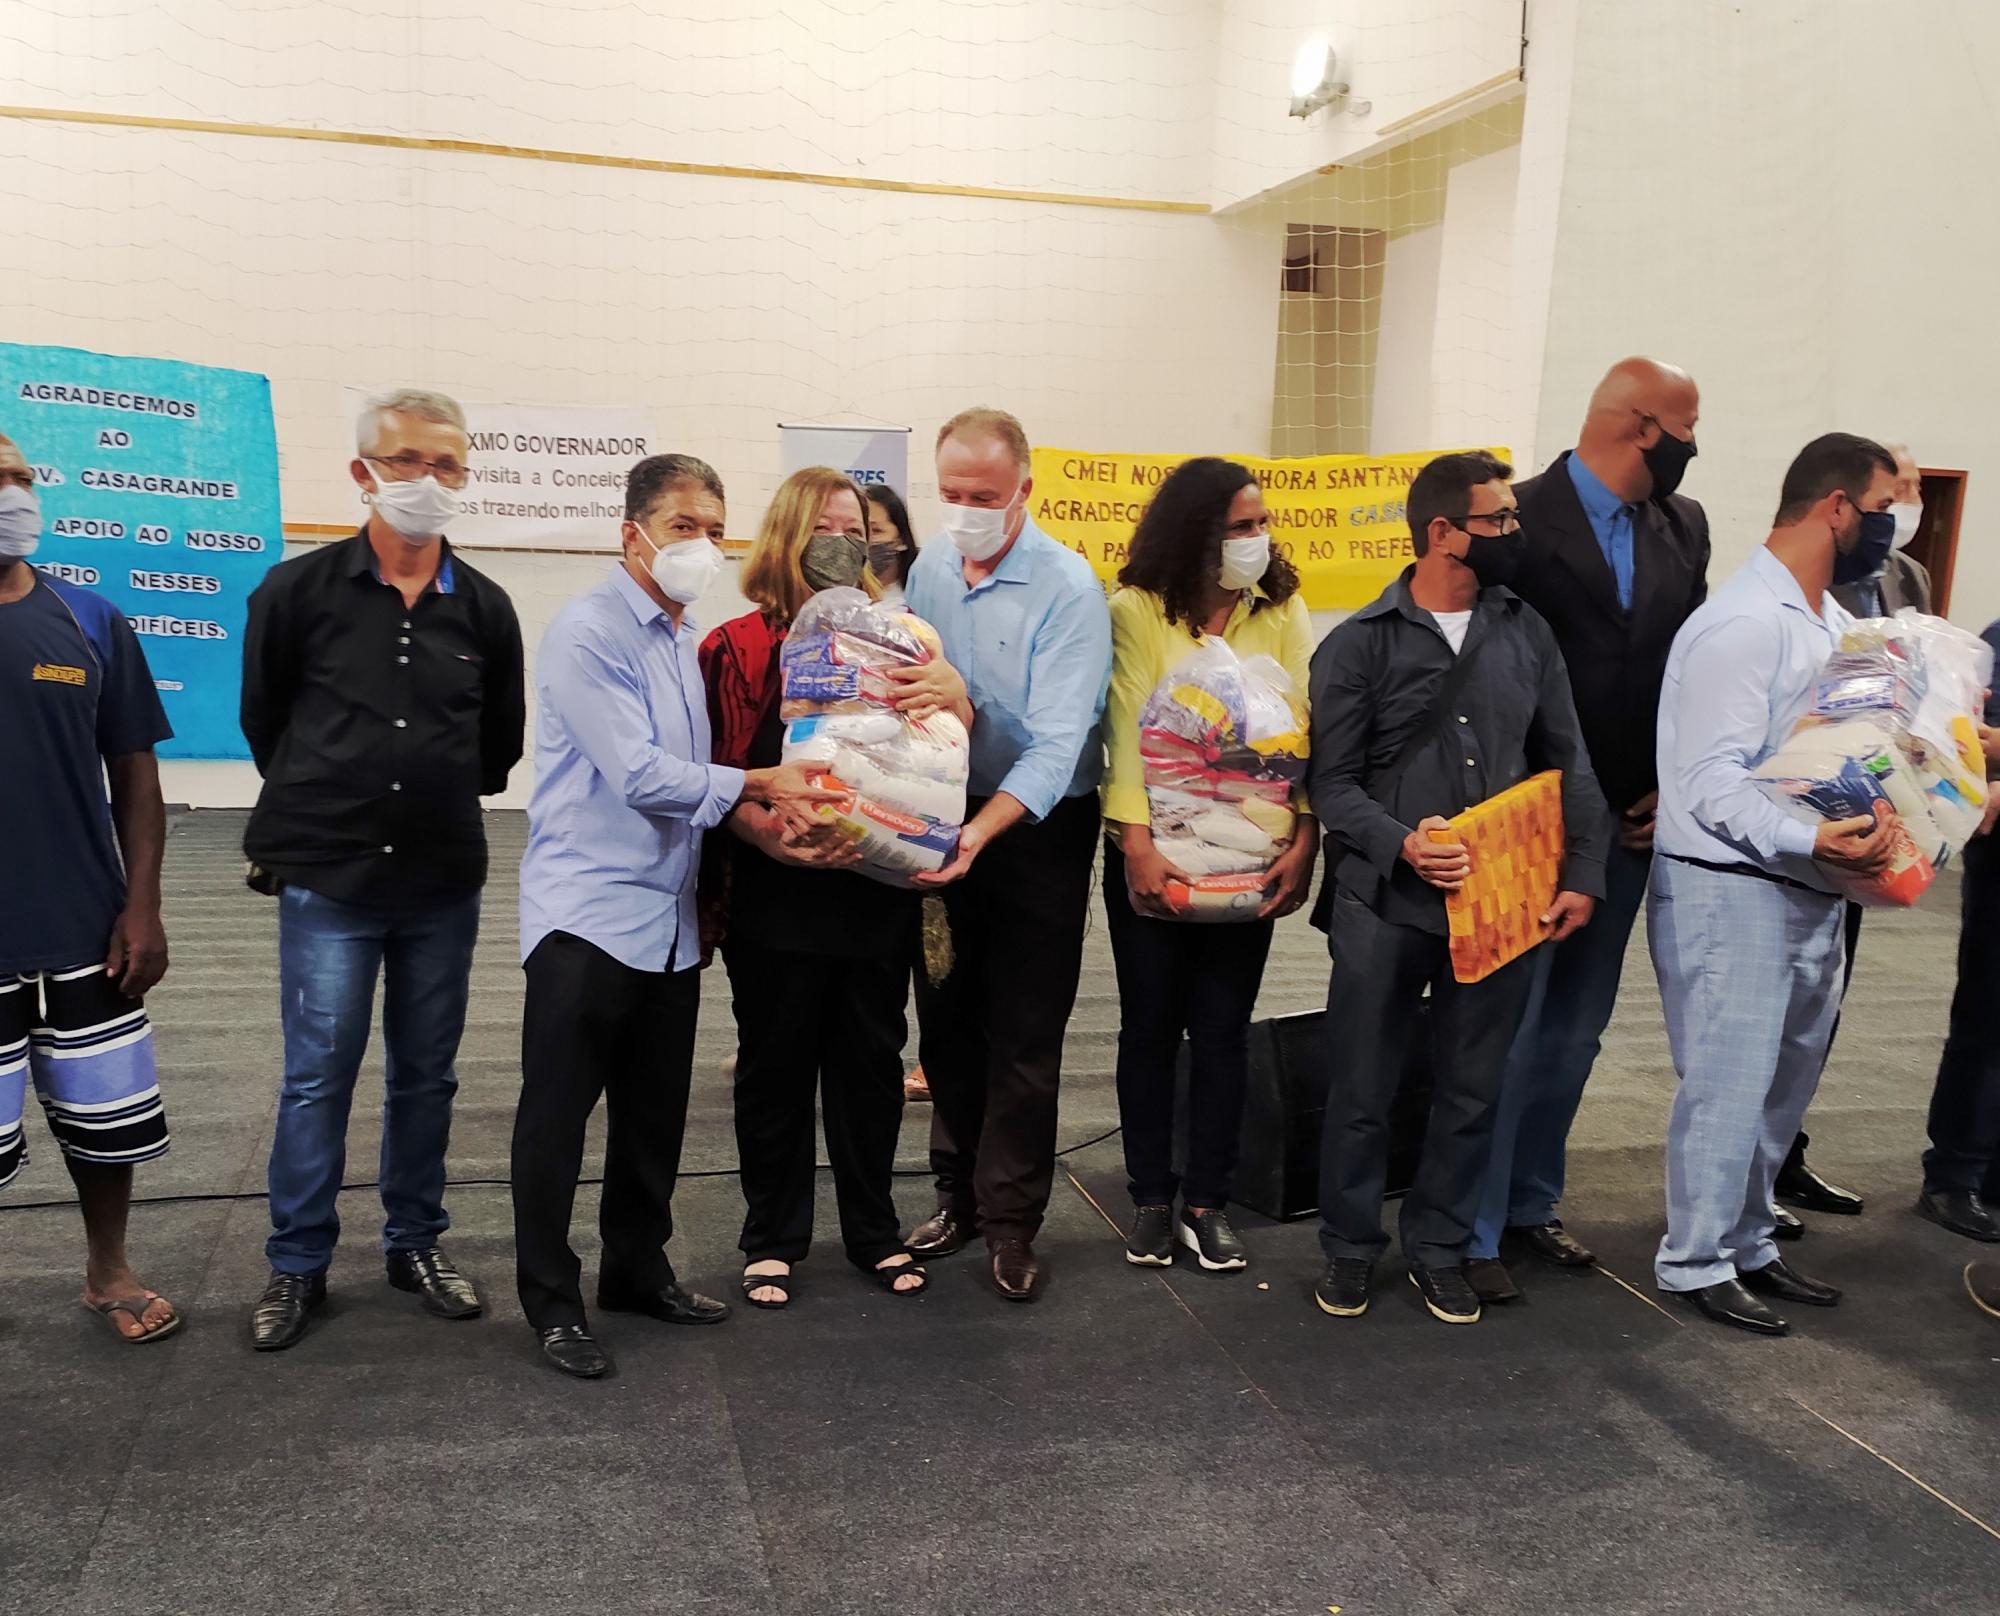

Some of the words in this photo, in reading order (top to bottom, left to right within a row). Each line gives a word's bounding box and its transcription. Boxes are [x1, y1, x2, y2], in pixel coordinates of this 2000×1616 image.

[20, 384, 197, 418] AGRADECEMOS
[99, 431, 129, 447] AO
[514, 434, 649, 456] GOVERNADOR
[472, 466, 521, 485] visita
[531, 471, 542, 486] a
[1063, 459, 1118, 484] CMEI
[81, 470, 236, 498] CASAGRANDE
[482, 498, 560, 519] trazendo
[54, 519, 124, 537] APOIO
[138, 527, 168, 543] AO
[186, 532, 262, 551] NOSSO
[1308, 540, 1335, 560] AO
[132, 572, 218, 592] NESSES
